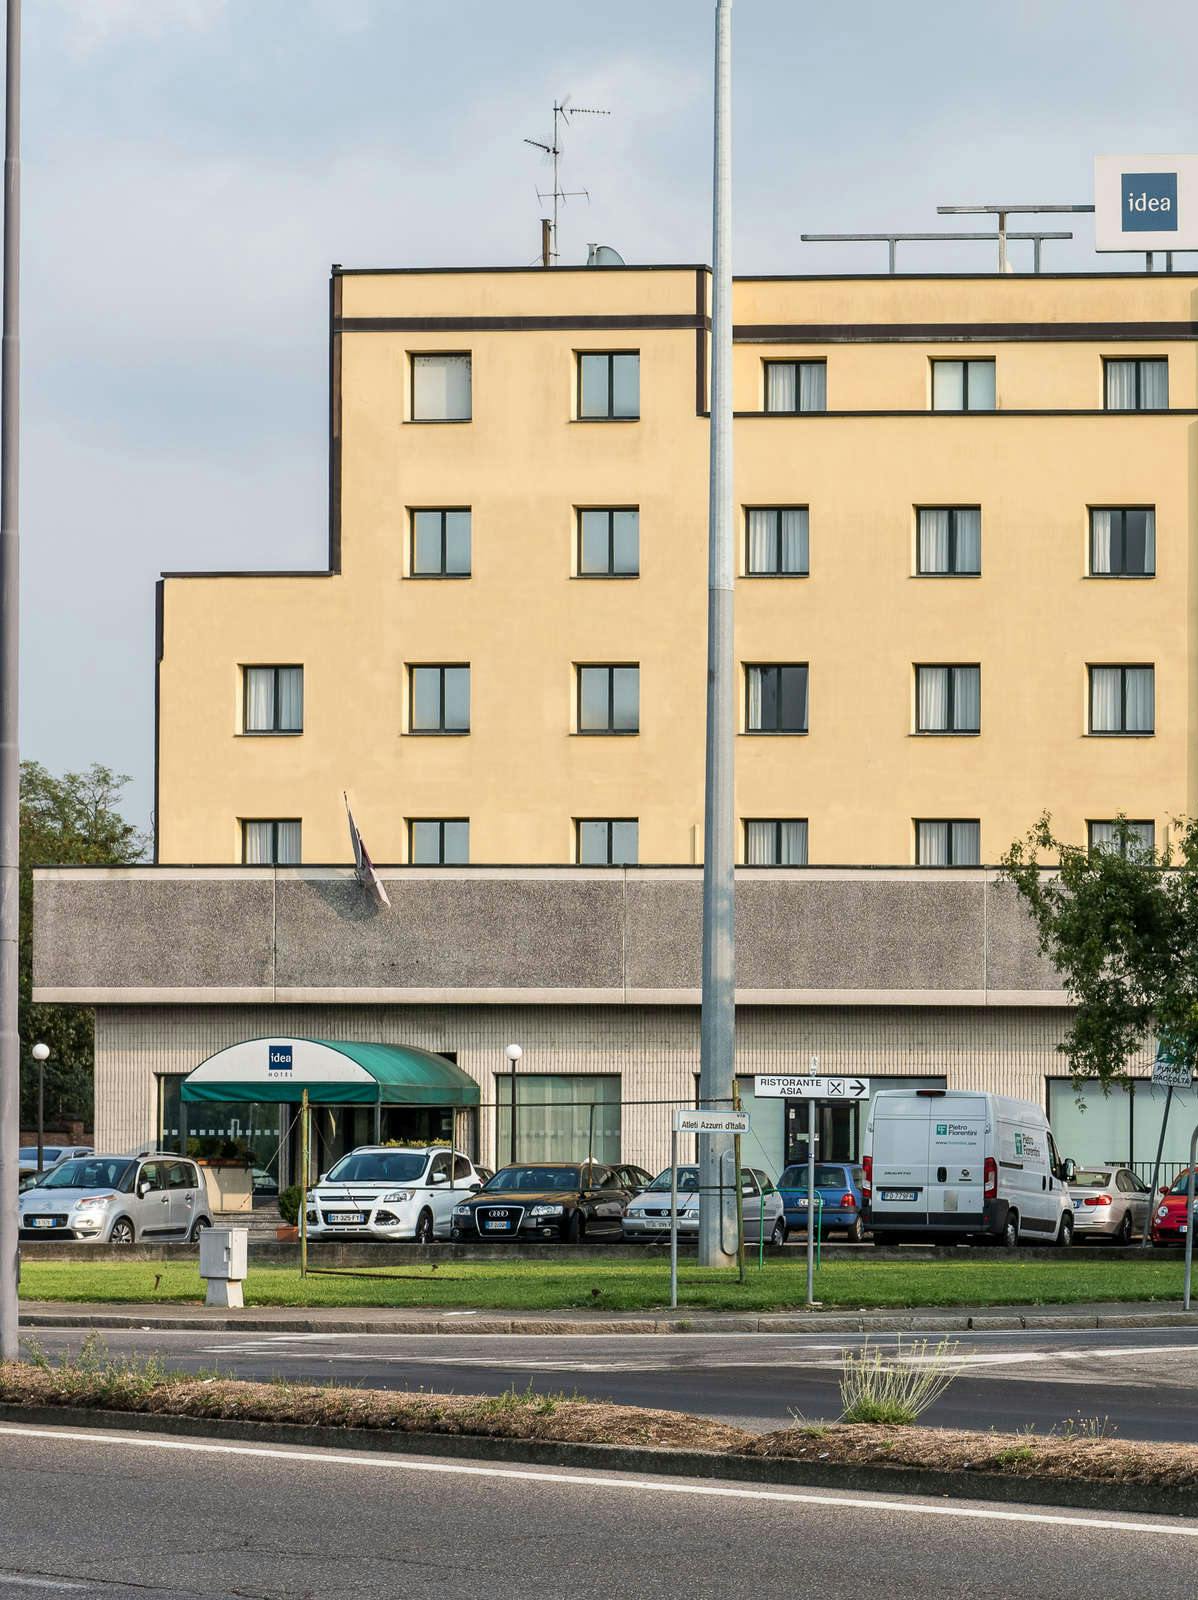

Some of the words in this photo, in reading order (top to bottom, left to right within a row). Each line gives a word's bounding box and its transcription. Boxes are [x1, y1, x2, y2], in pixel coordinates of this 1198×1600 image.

[1128, 192, 1171, 212] idea
[271, 1052, 292, 1063] idea
[760, 1079, 822, 1087] RISTORANTE
[779, 1087, 803, 1096] ASIA
[682, 1120, 699, 1129] Atleti
[701, 1121, 723, 1129] Azzurri
[725, 1121, 746, 1130] d'Italia
